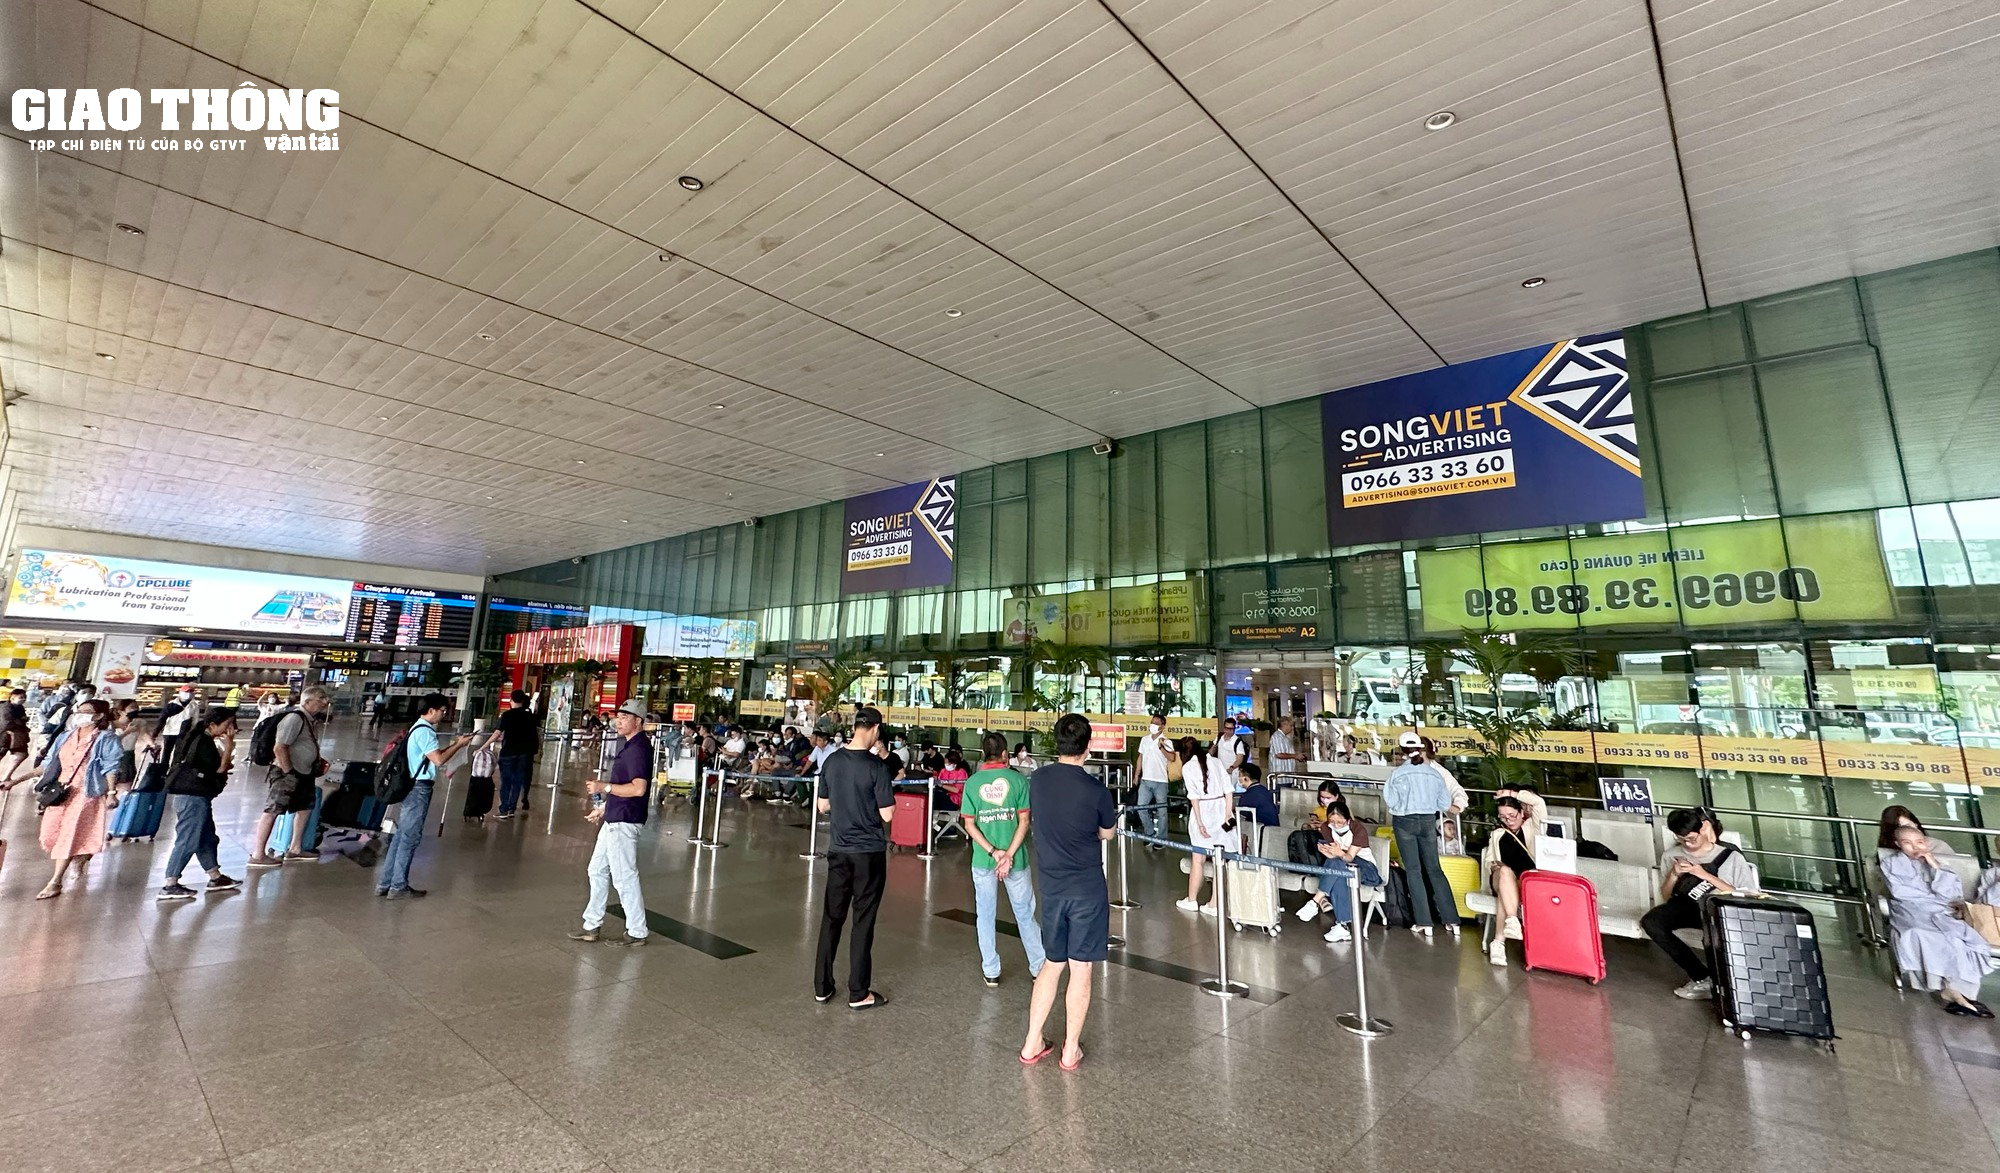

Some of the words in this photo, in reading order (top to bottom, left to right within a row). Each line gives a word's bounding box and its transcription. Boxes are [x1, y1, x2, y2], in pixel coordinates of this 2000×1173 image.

[1340, 401, 1508, 452] SONGVIET
[1383, 429, 1512, 462] ADVERTISING
[1351, 470, 1401, 491] 0966
[1408, 466, 1434, 483] 33
[1441, 461, 1468, 479] 33
[1476, 456, 1505, 474] 60
[1352, 476, 1507, 503] ADVERTISING@SONGVIET.COM.VN
[850, 511, 913, 536] SONGVIET
[865, 528, 913, 545] ADVERTISING
[851, 550, 871, 561] 0966
[873, 548, 883, 558] 33
[885, 546, 895, 556] 33
[897, 544, 909, 555] 60
[136, 579, 193, 588] CPCLUBE
[59, 586, 121, 598] Lubrication
[124, 591, 189, 603] Professional
[409, 589, 436, 597] Arrivals
[121, 600, 147, 609] from
[150, 602, 186, 612] Taiwan
[1300, 627, 1316, 637] A2
[1184, 727, 1193, 735] 33
[1509, 743, 1535, 752] 0933
[1537, 744, 1551, 753] 33
[1554, 745, 1568, 754] 99
[1571, 746, 1585, 754] 88
[1604, 747, 1633, 757] 0933
[1636, 748, 1652, 758] 33
[1655, 749, 1670, 758] 99
[1673, 750, 1689, 759] 88
[1610, 804, 1624, 812] GHẾ
[1235, 854, 1250, 862] TIA
